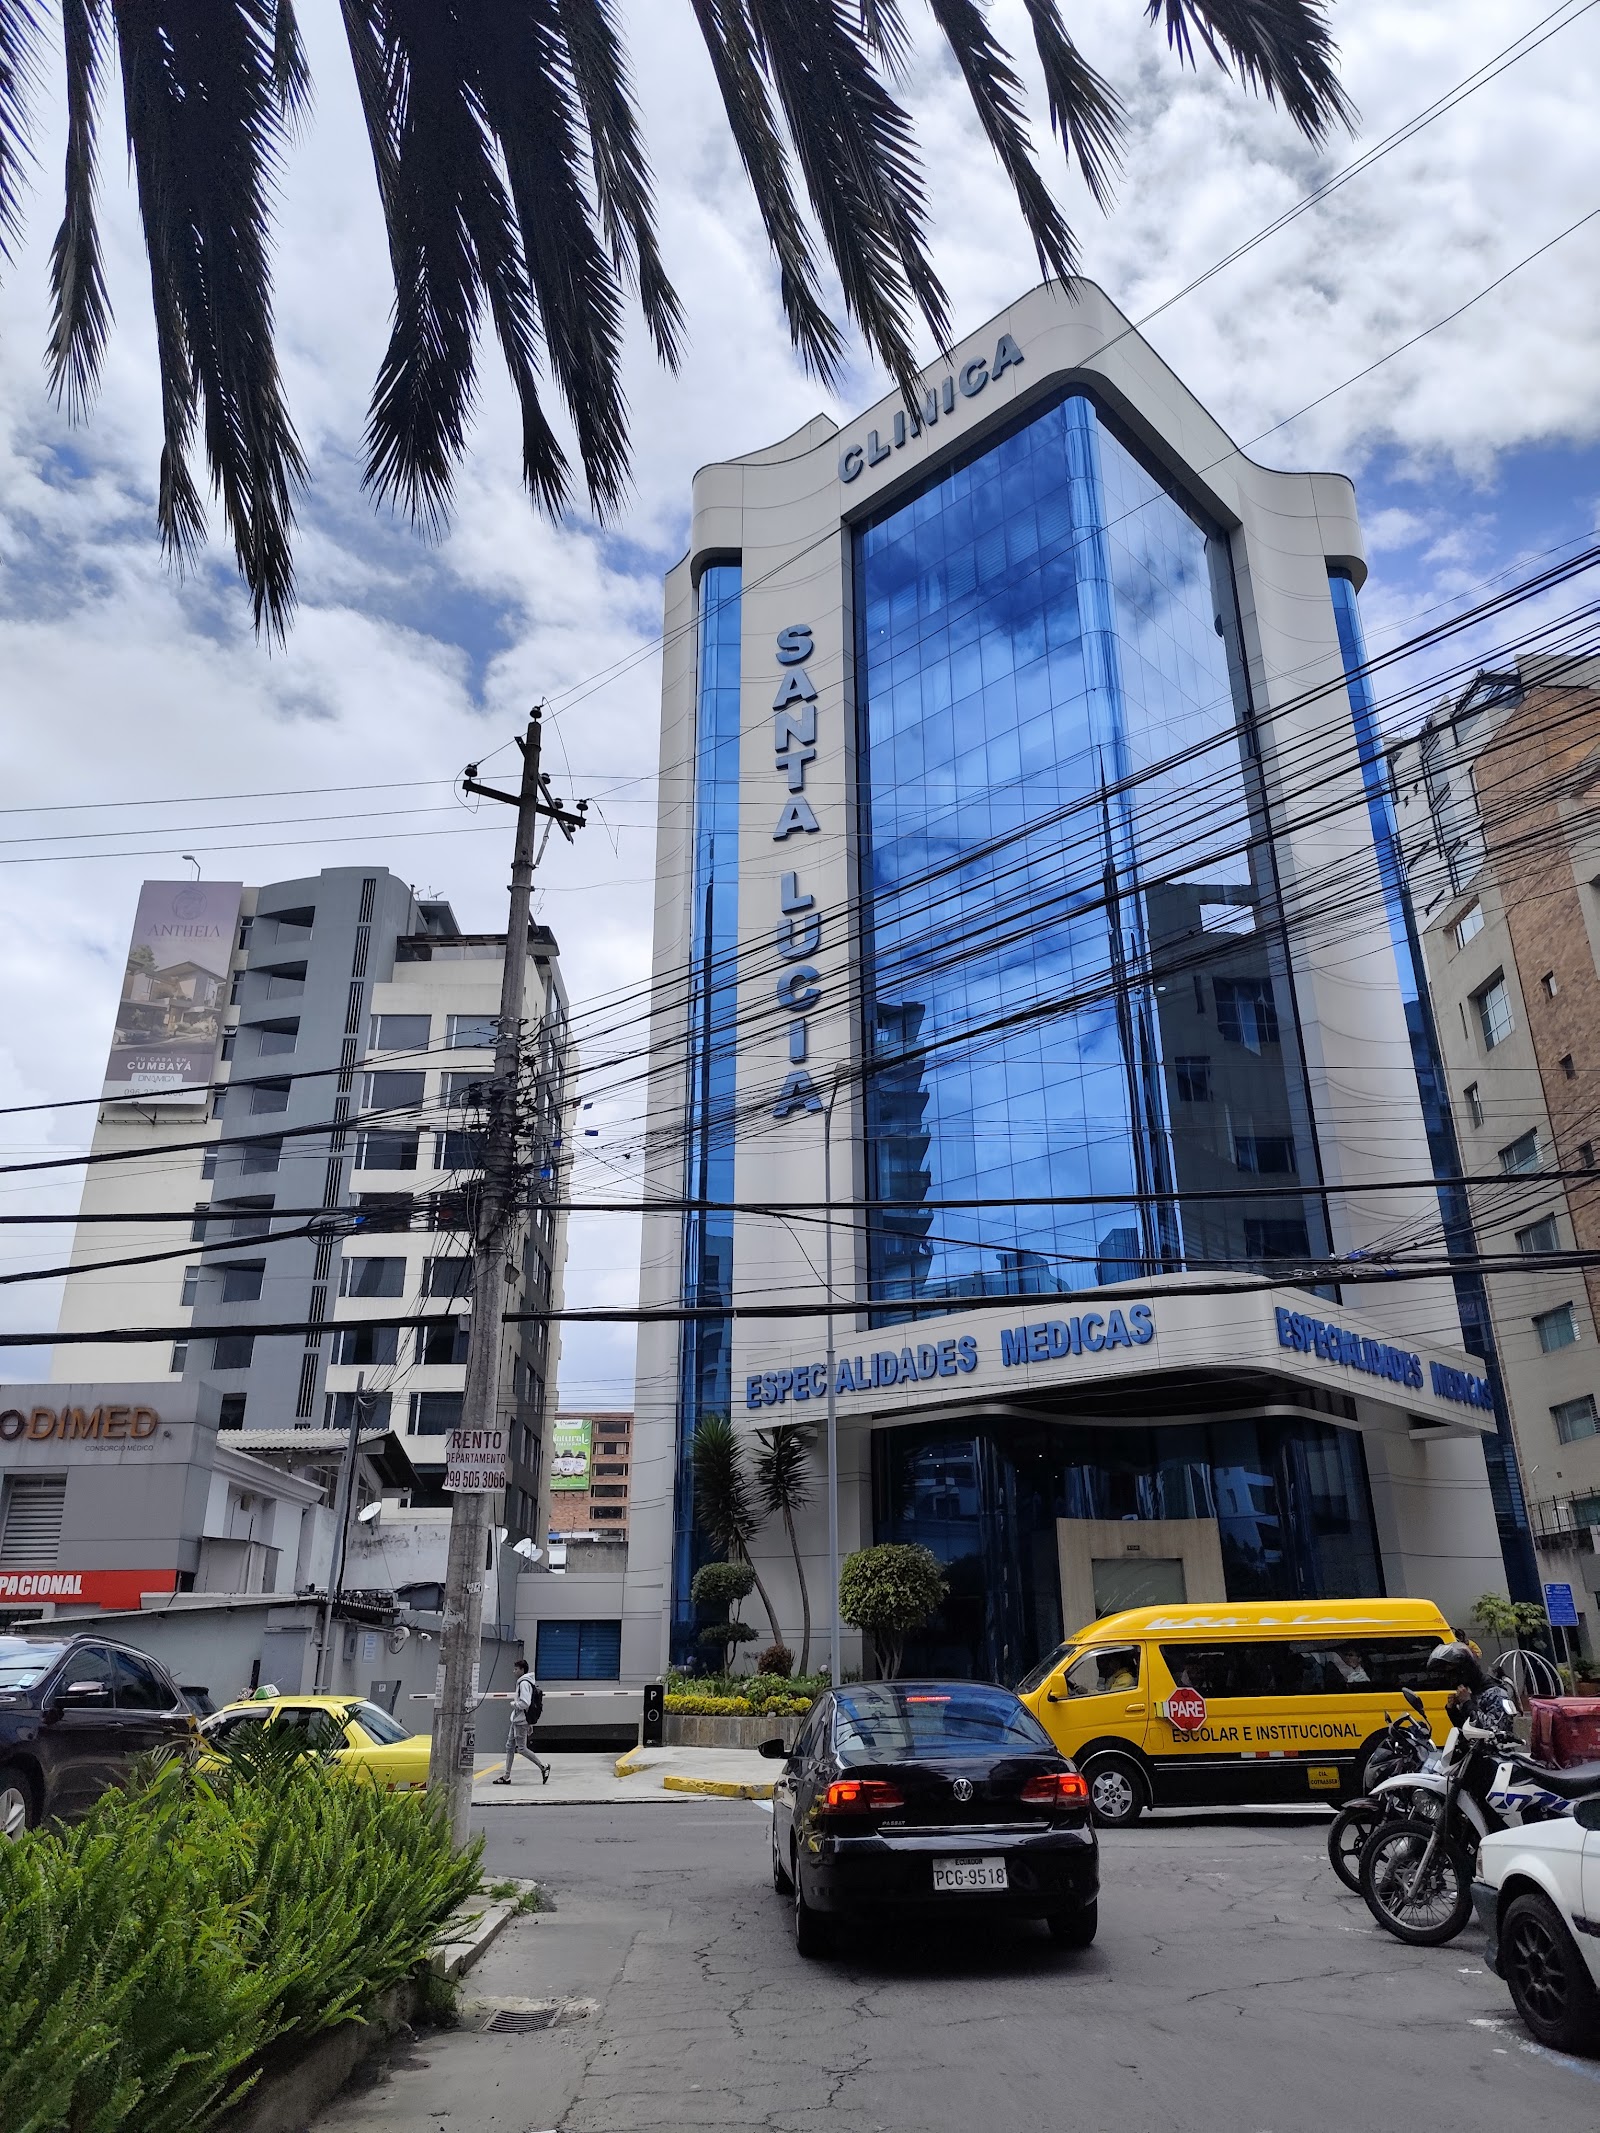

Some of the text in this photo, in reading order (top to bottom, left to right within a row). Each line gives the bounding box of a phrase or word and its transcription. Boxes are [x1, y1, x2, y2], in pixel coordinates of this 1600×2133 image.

[838, 333, 1024, 483] CLINICA
[772, 624, 827, 1119] SANTA LUCIA
[147, 924, 220, 937] ANTHEIA
[127, 1061, 192, 1071] CUMBAYÁ
[746, 1304, 1155, 1409] ESPECALIDADES MEDICAS
[1275, 1306, 1424, 1389] ESPECIALIDADES
[452, 1431, 502, 1449] RENTO
[447, 1453, 506, 1463] DEPARTAMENTO
[462, 1470, 480, 1488] 505
[482, 1470, 505, 1488] 3066
[651, 1691, 657, 1700] P
[1170, 1701, 1204, 1717] PARE
[1172, 1723, 1362, 1743] ESCOLAR E INSTITUCIONAL
[936, 1868, 1005, 1887] PCG-9518
